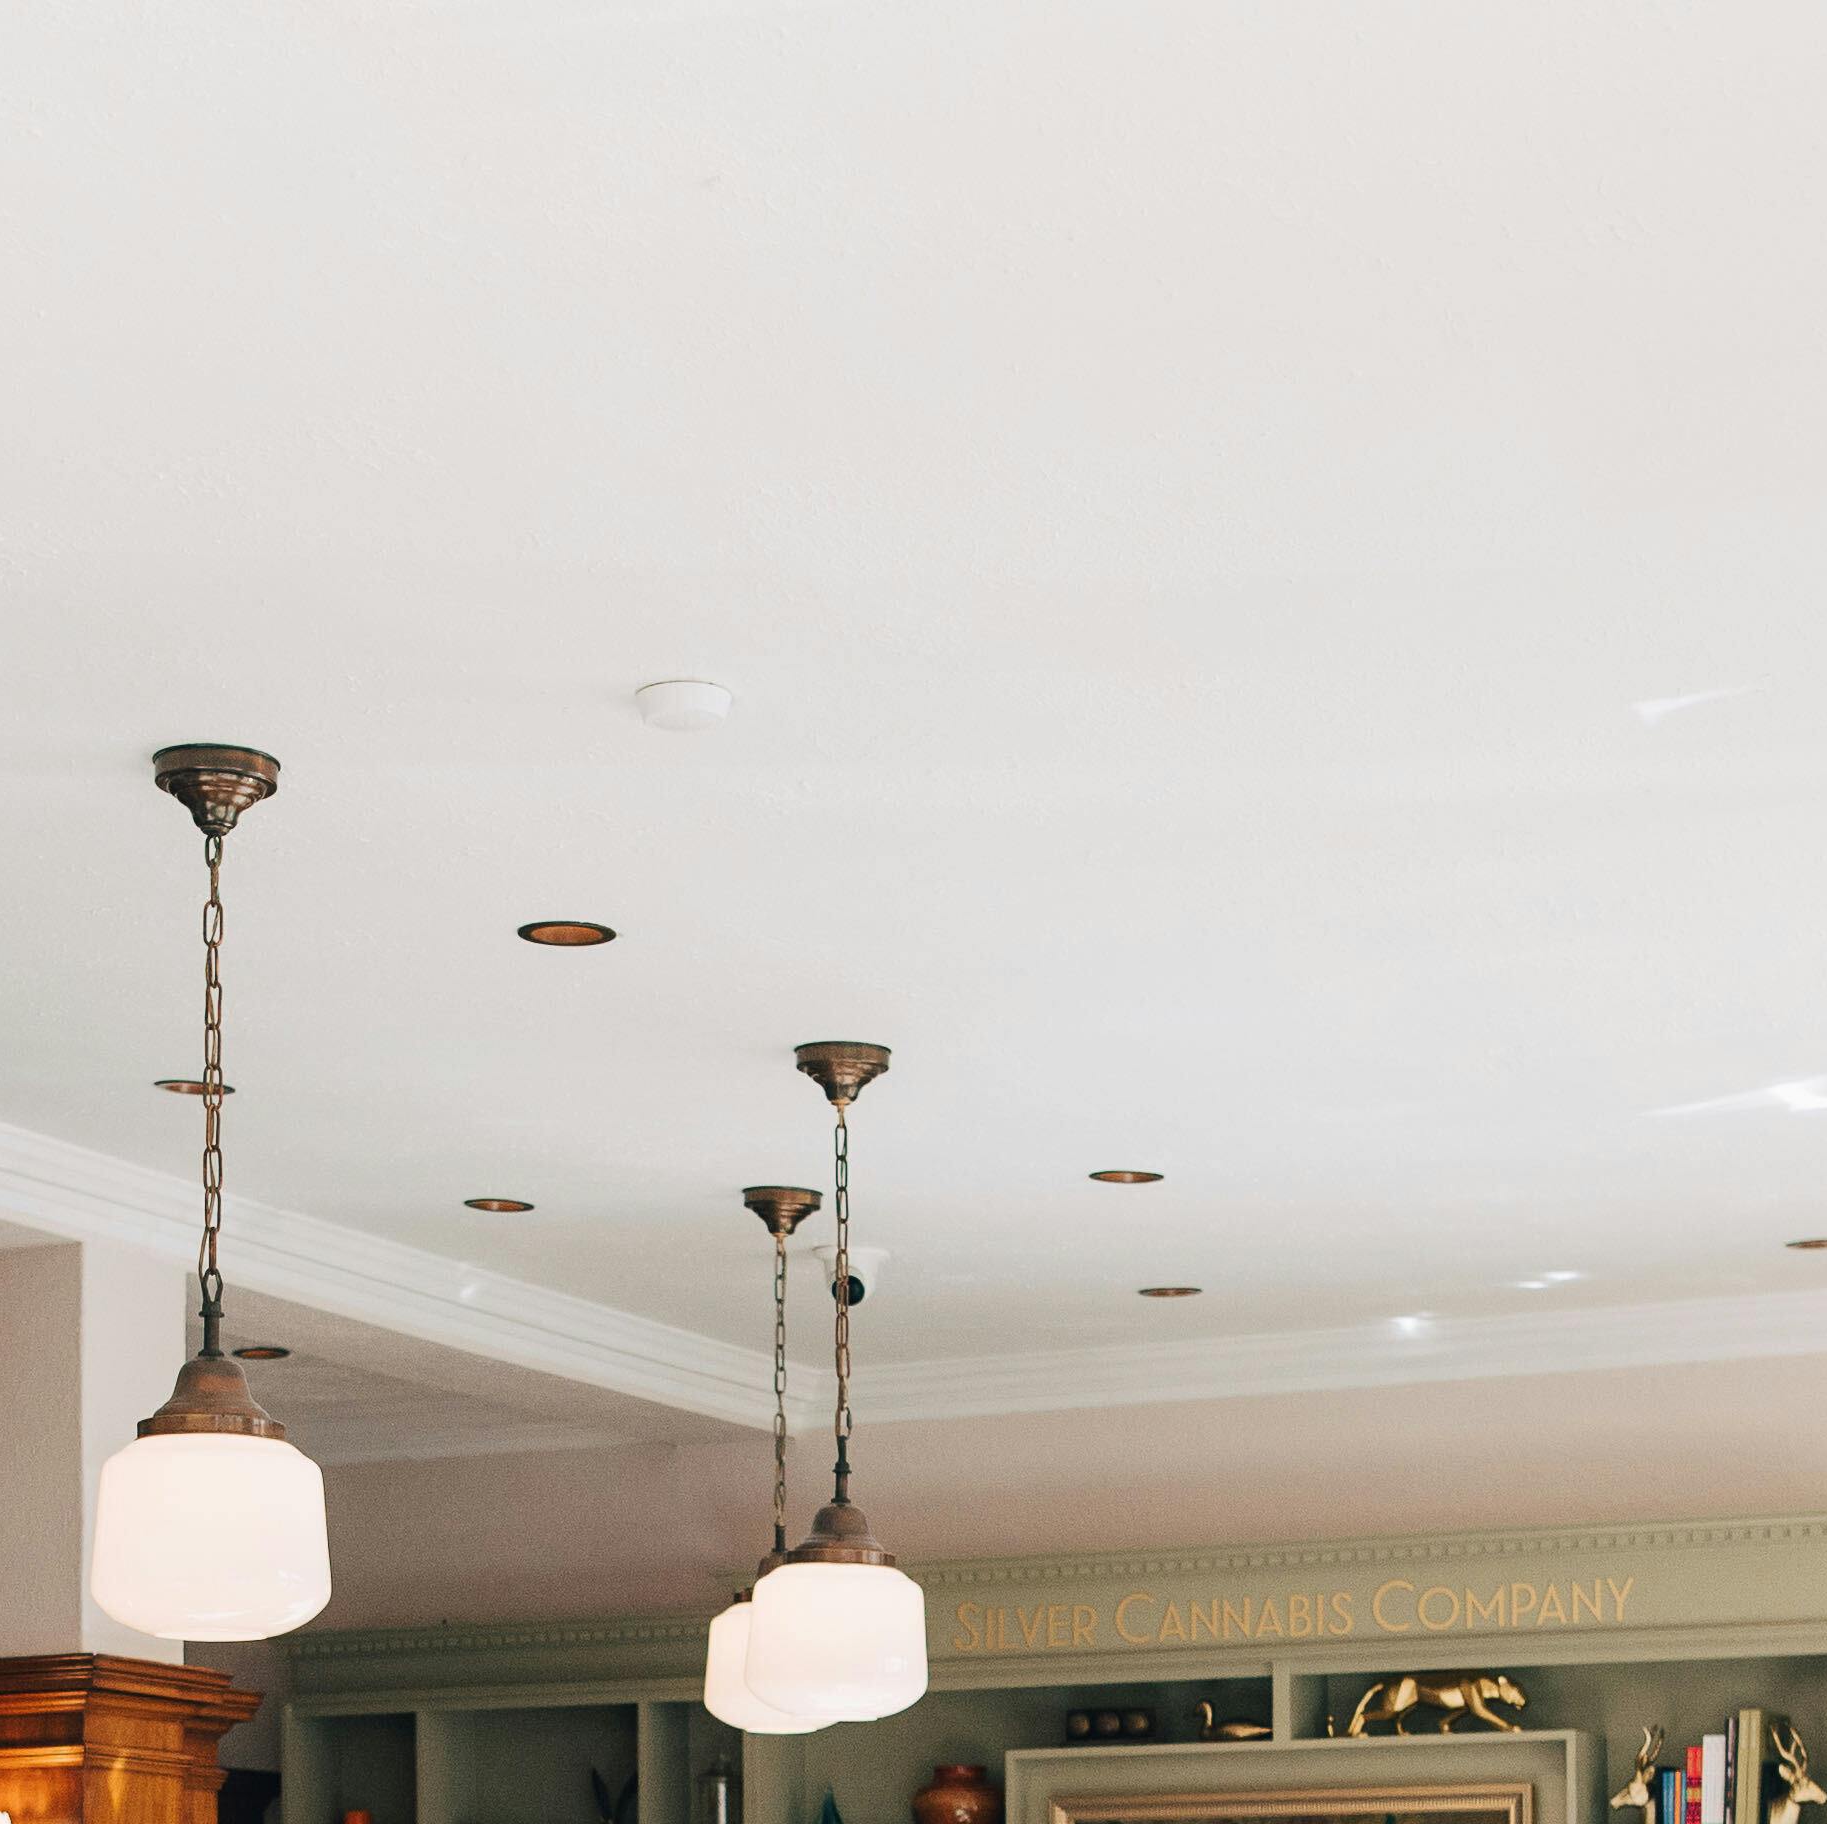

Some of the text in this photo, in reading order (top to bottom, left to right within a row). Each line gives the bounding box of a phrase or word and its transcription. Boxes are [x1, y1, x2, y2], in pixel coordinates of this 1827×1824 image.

[953, 1576, 1635, 1652] SILVER CANNABIS COMPANY
